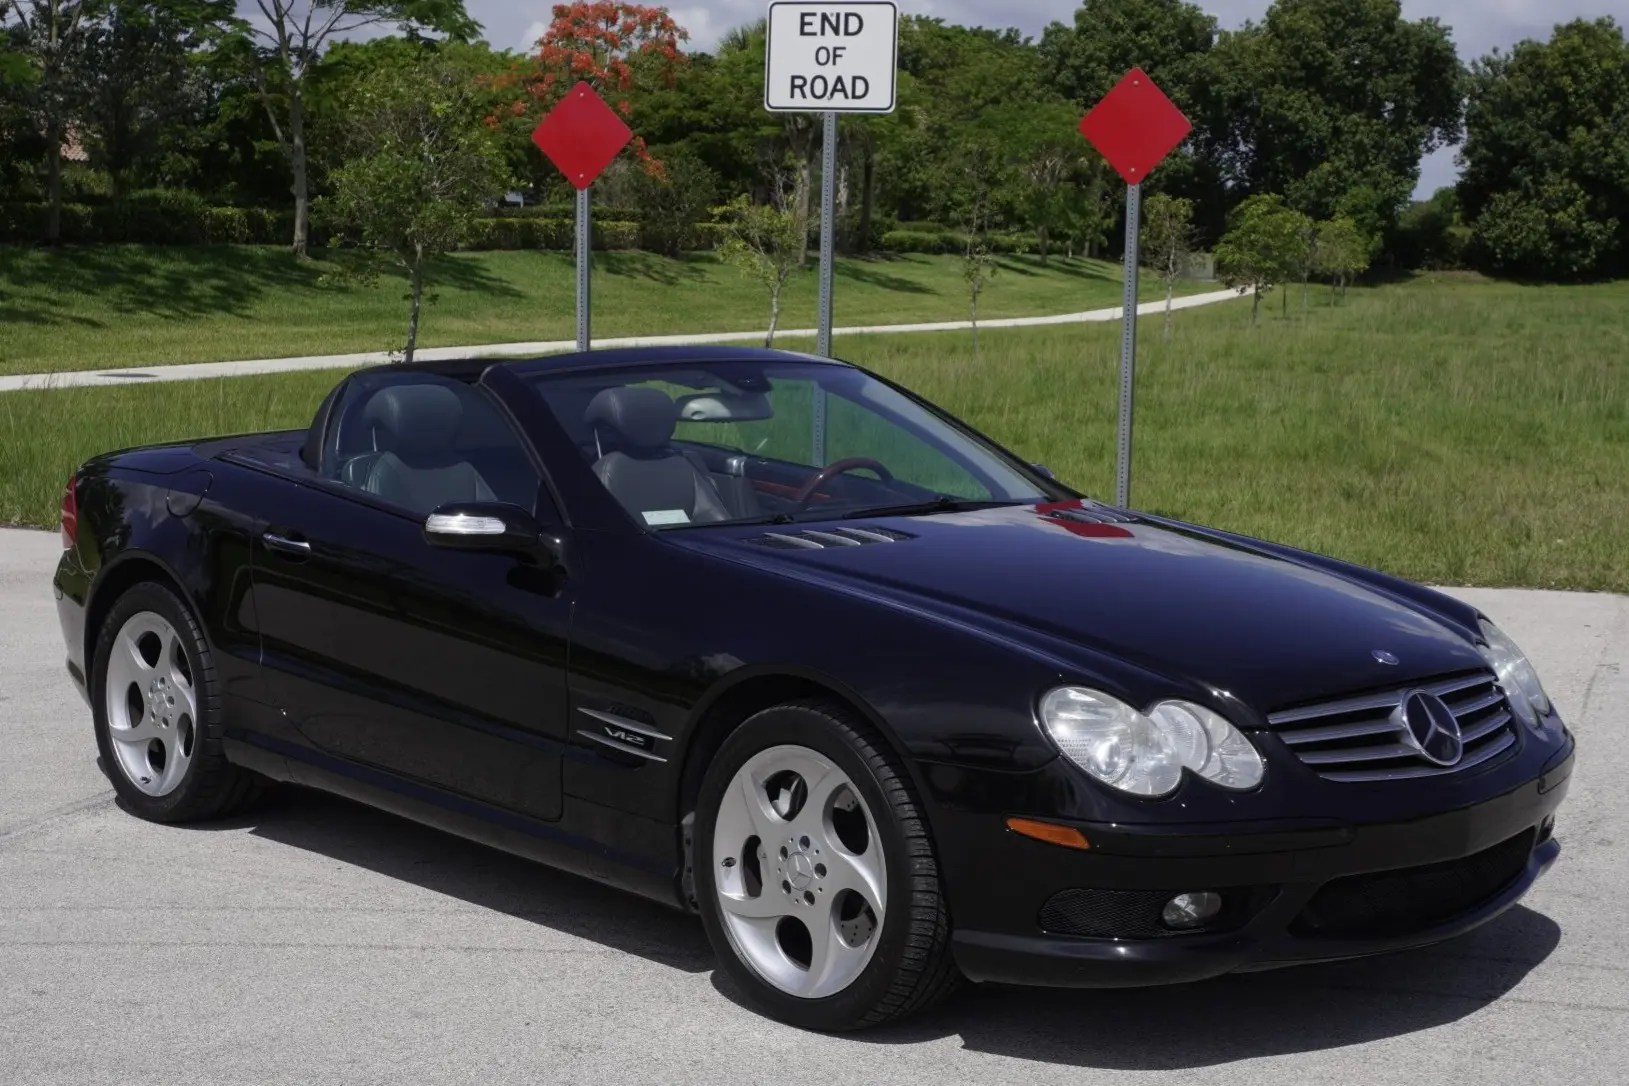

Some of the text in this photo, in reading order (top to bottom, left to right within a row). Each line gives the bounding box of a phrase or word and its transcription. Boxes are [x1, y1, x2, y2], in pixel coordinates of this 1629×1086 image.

[799, 12, 864, 36] END
[815, 46, 847, 66] OF
[789, 74, 870, 100] ROAD
[604, 726, 645, 746] V12
